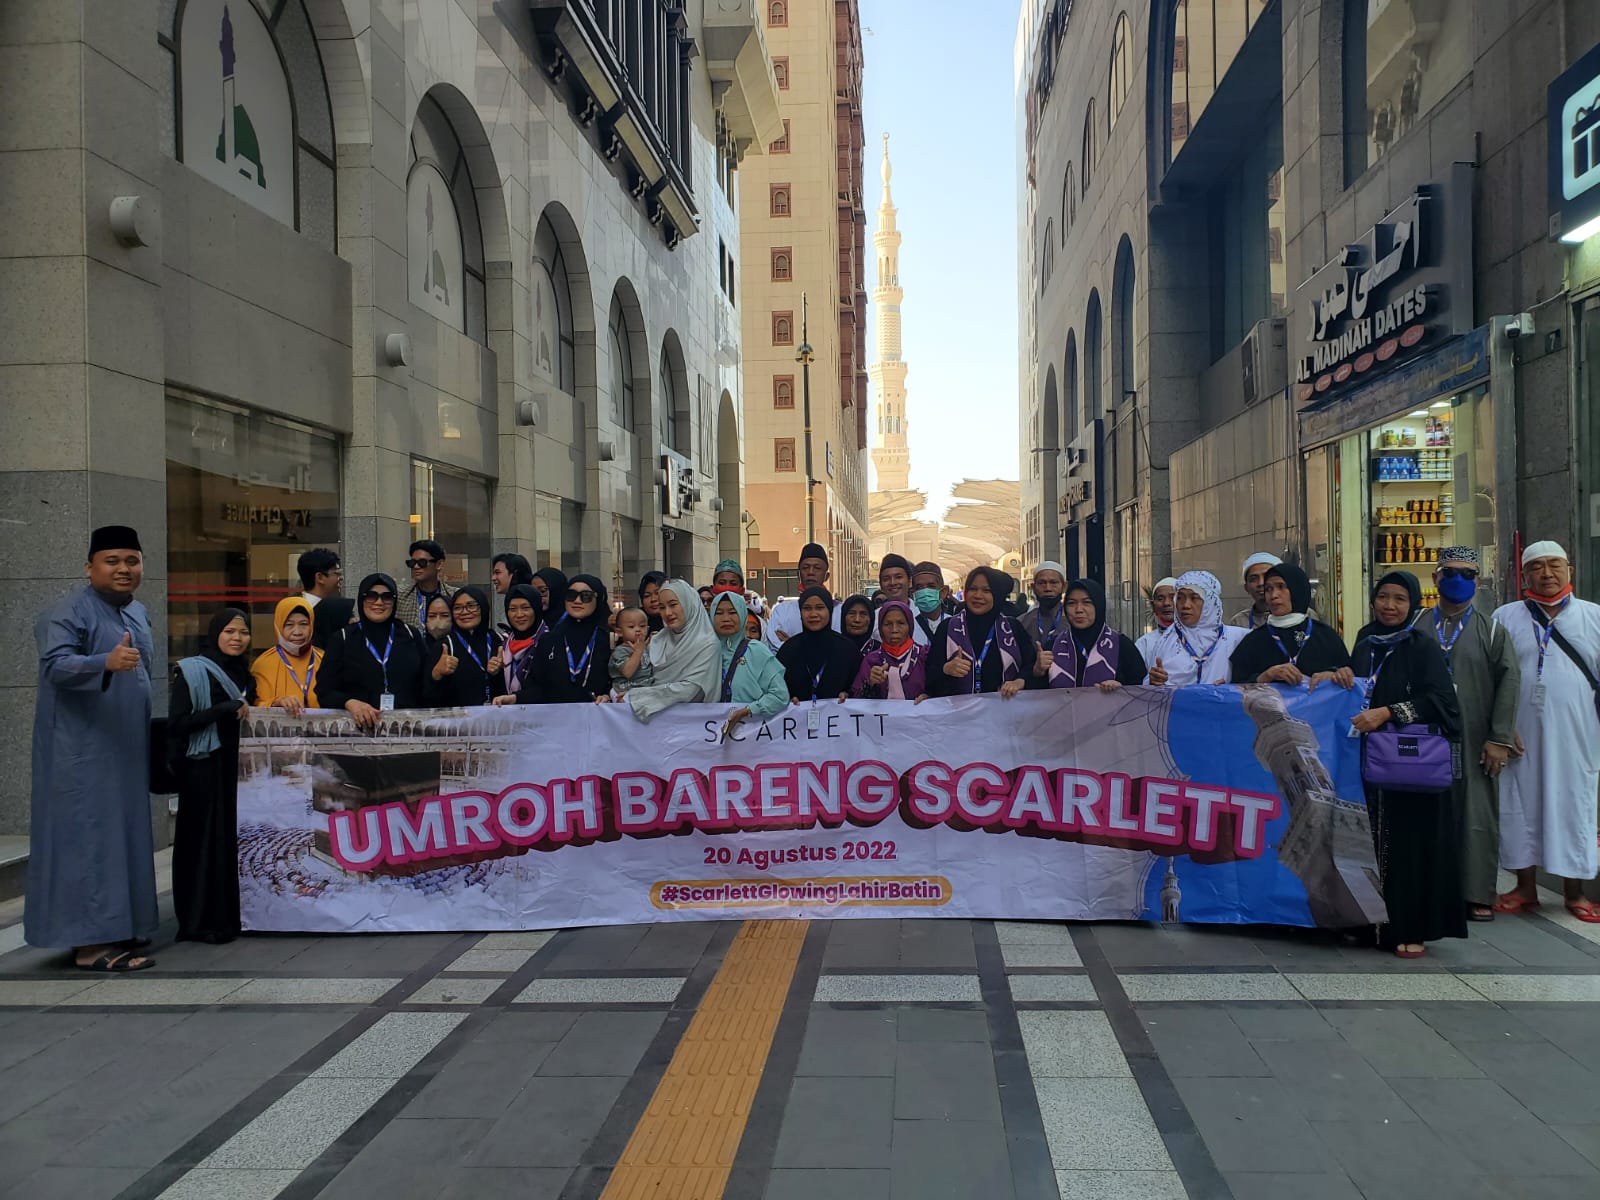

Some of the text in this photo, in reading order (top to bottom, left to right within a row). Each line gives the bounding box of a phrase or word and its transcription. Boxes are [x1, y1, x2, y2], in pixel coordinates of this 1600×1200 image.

[1296, 284, 1427, 382] AL MADINAH DATES
[332, 763, 1275, 866] UMROH BARENG SCARLETT
[703, 840, 897, 870] 20 Agustus 2022
[661, 880, 942, 904] #ScarlettGlowingLahirBatin
